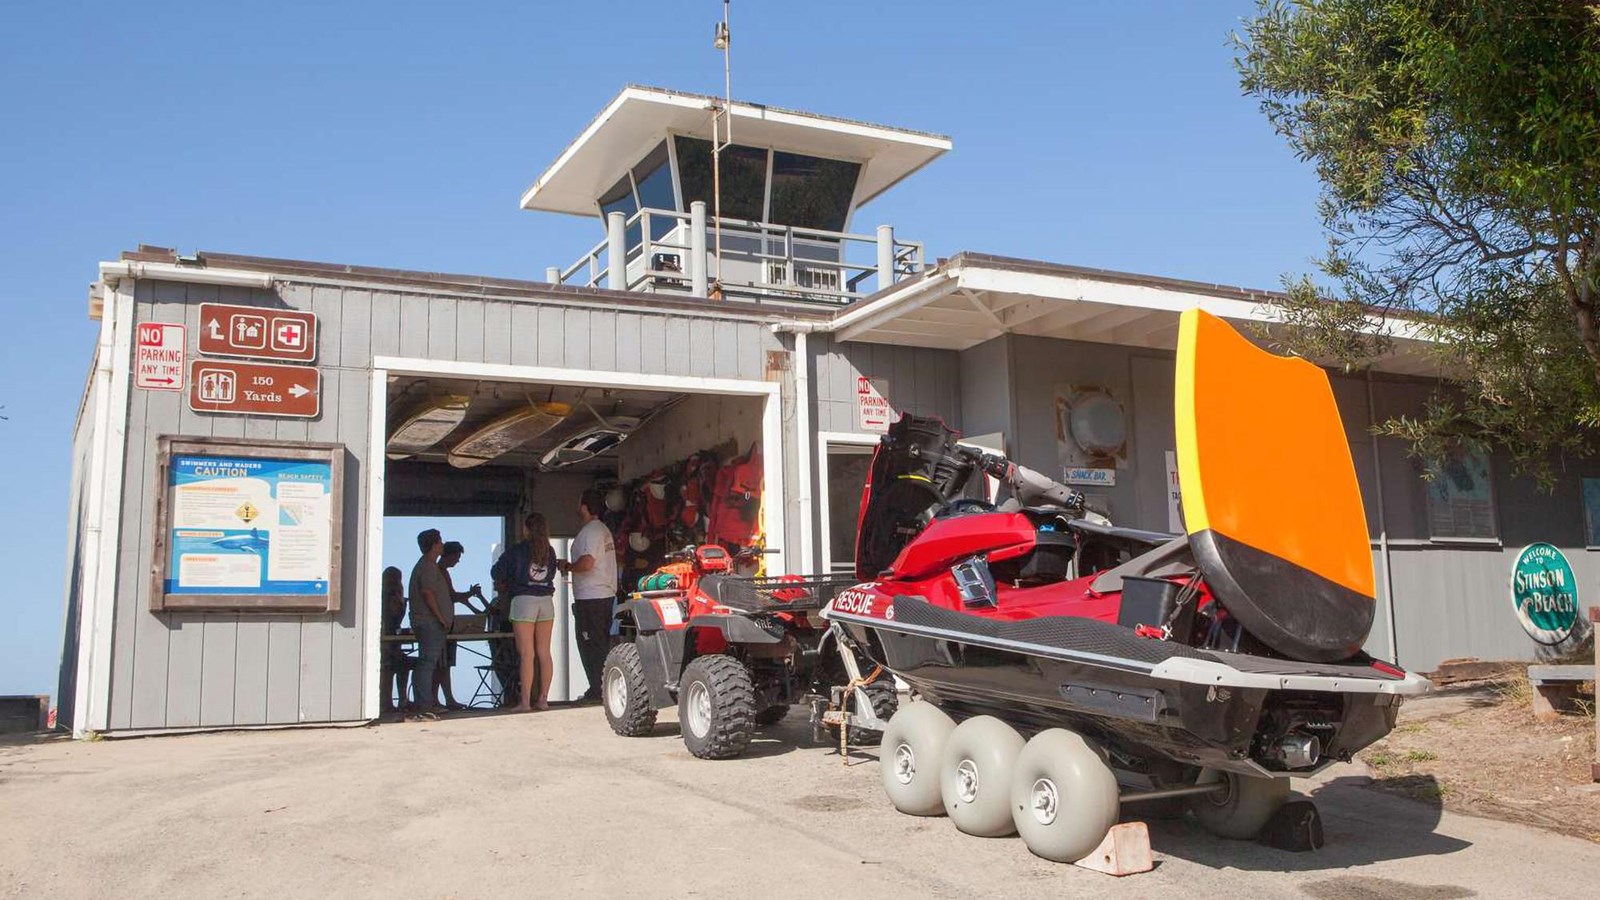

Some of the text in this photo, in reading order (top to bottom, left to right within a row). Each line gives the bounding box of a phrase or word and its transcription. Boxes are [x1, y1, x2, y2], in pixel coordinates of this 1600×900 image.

[140, 328, 161, 343] NO
[141, 348, 181, 362] PARKING
[141, 364, 181, 376] ANY TIME
[252, 376, 274, 386] 150
[858, 379, 870, 392] NO
[242, 390, 282, 402] Yards
[860, 396, 888, 407] PARKING
[863, 408, 888, 417] ANY TIME
[194, 466, 248, 477] CAUTION
[1071, 470, 1092, 480] SNACK
[1523, 548, 1557, 564] WELCOME
[1516, 568, 1565, 593] STINSON
[834, 590, 876, 614] RESCUE
[1533, 592, 1573, 612] BEACH
